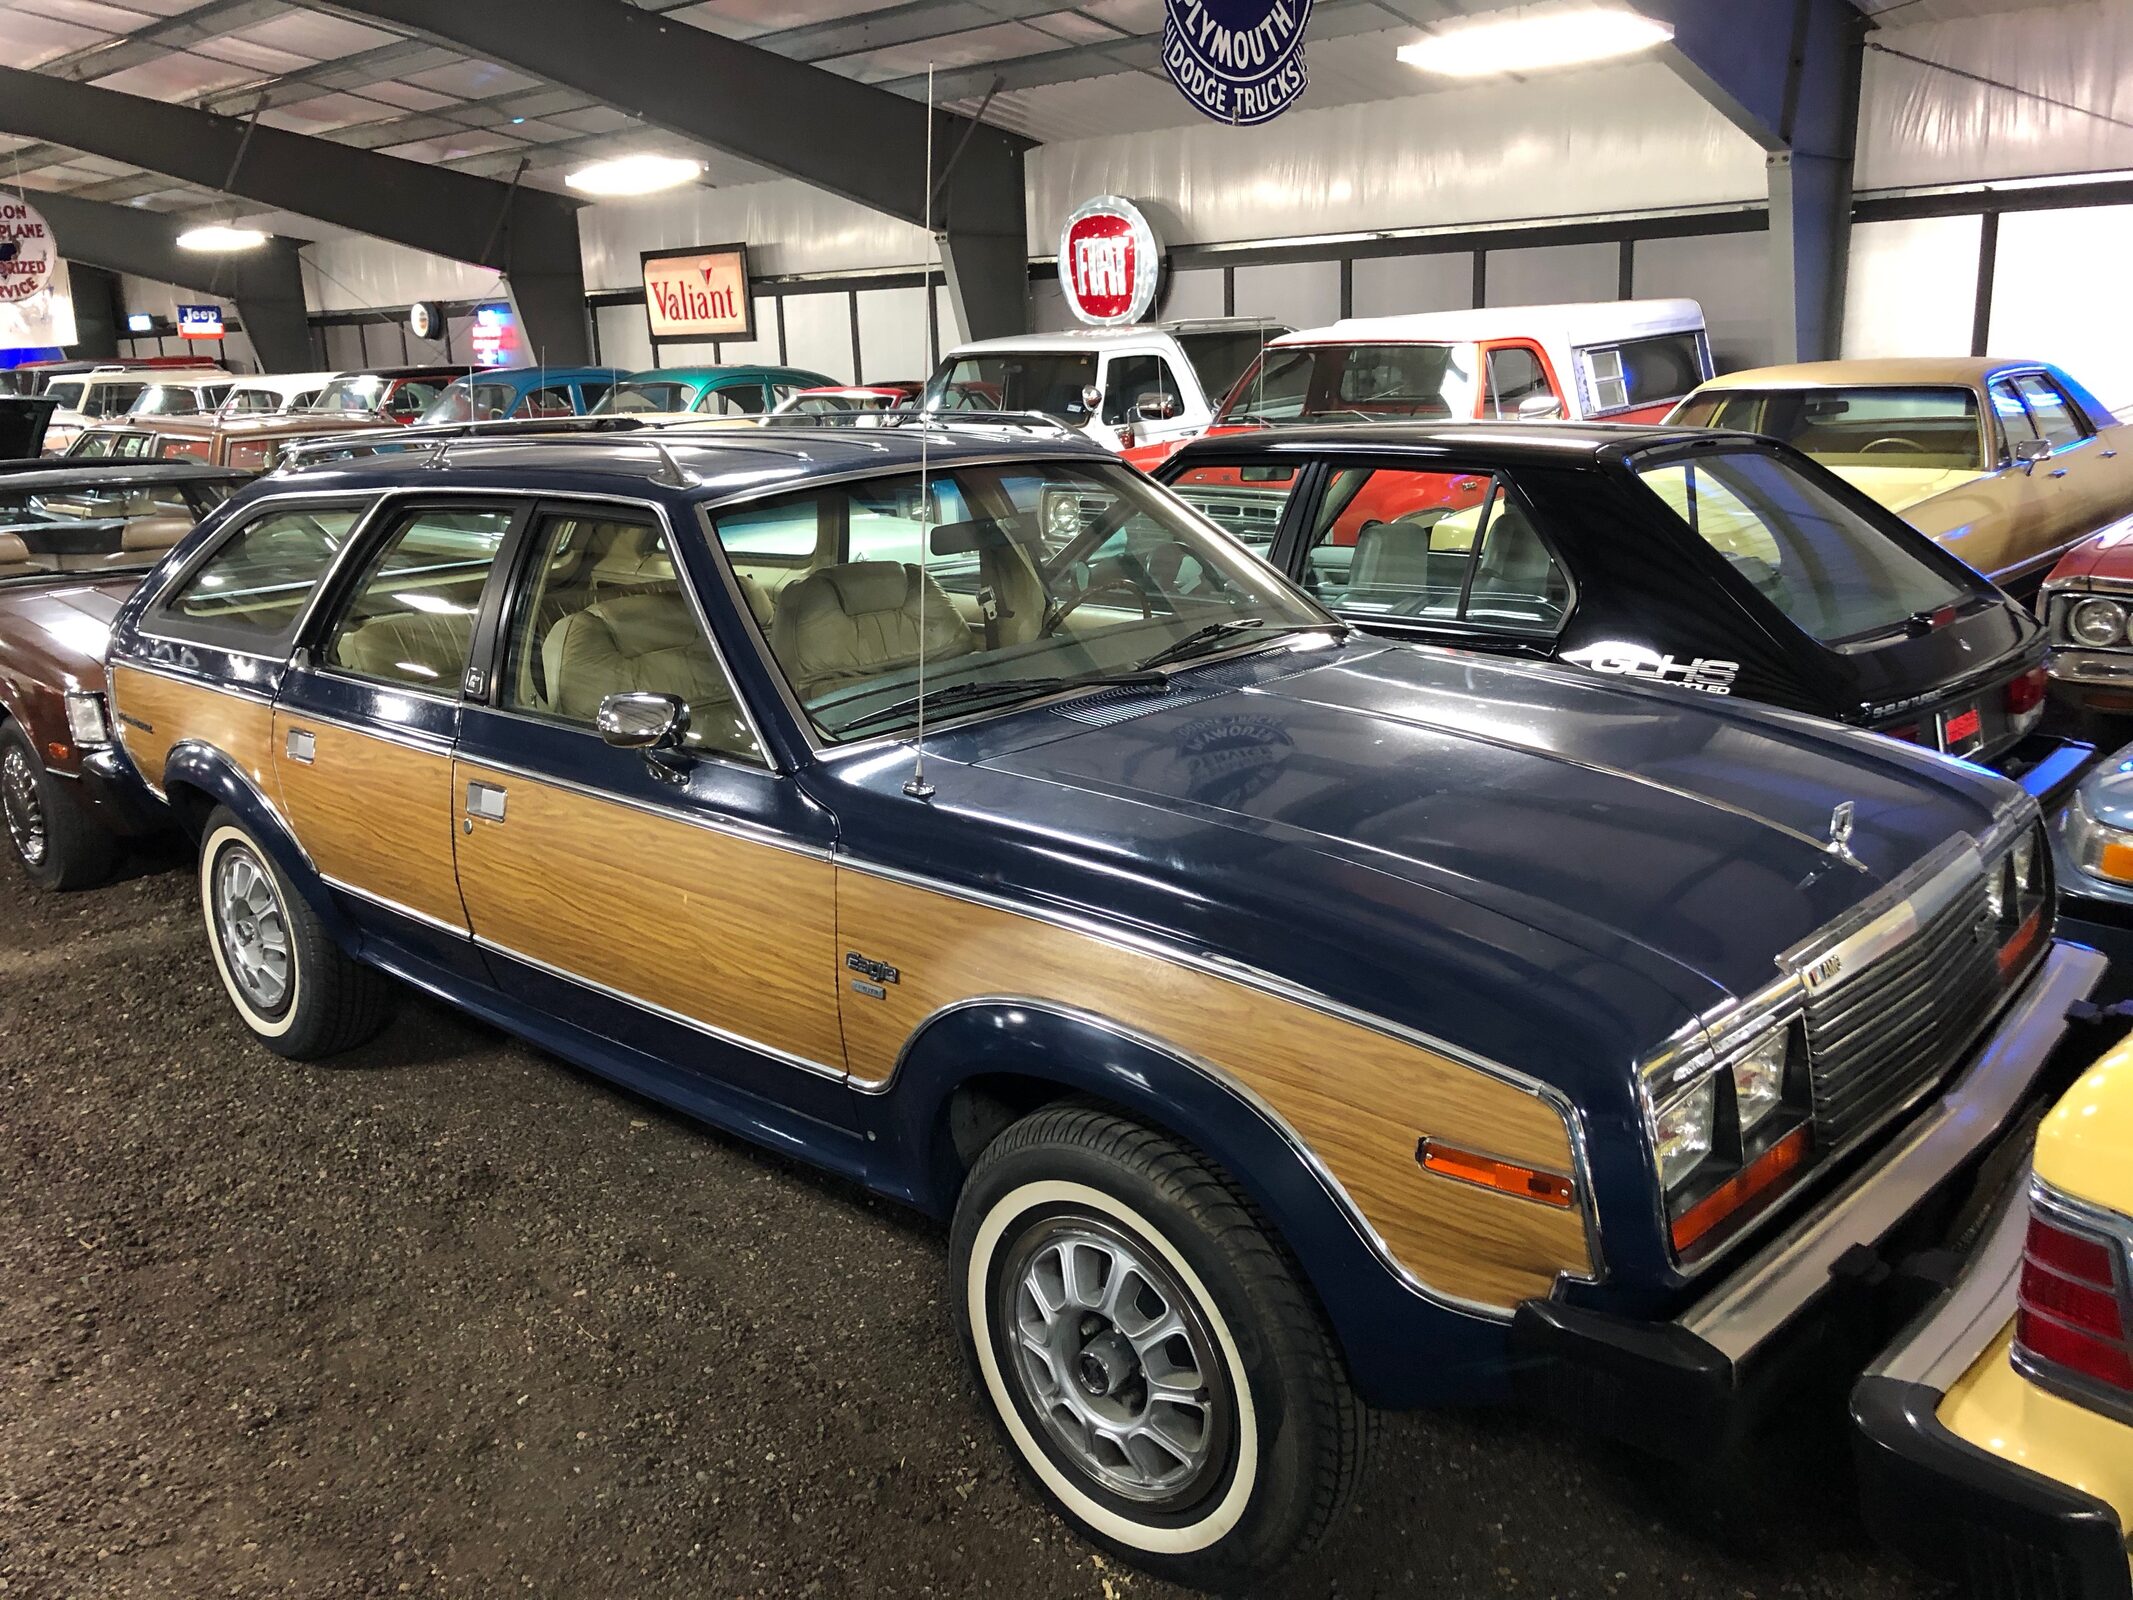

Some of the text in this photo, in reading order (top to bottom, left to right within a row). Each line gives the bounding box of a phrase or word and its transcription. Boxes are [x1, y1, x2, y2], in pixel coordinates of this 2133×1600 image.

[1169, 40, 1300, 115] DODGE TRUCKS
[0, 205, 27, 219] ON
[1074, 236, 1130, 296] FIAT
[183, 307, 218, 324] Jeep
[650, 280, 738, 321] Valiant
